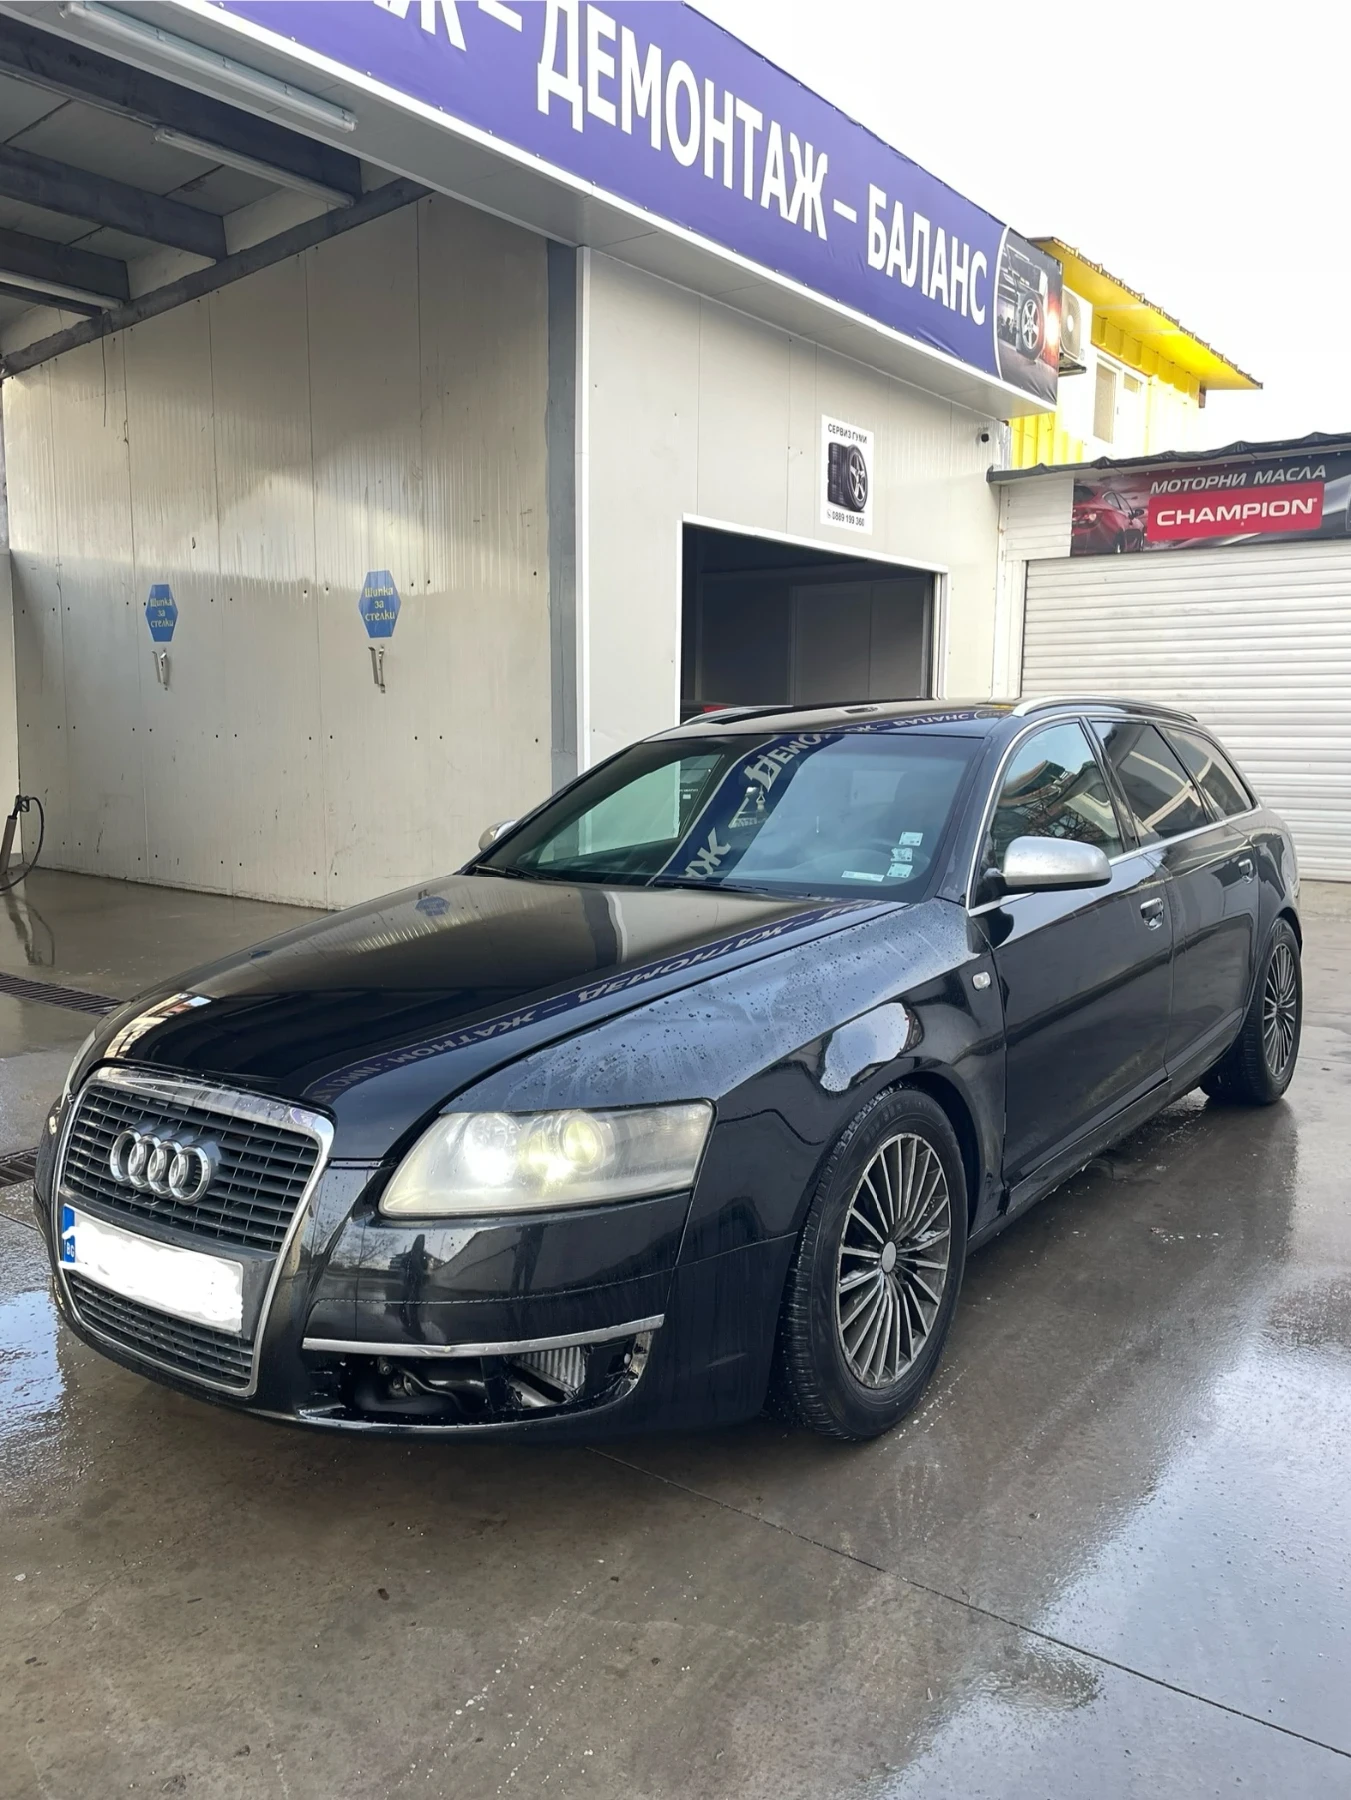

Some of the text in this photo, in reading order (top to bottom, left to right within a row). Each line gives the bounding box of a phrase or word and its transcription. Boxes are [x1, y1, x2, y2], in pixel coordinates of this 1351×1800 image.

[538, 0, 828, 241] ДЕМОНТАЖ
[867, 183, 988, 326] БАЛАНС
[828, 423, 868, 445] СЕРВИЗ ГУМИ
[1150, 464, 1327, 495] МОТОРНИ МАСЛА
[365, 586, 393, 598] Щипка
[375, 600, 384, 609] за
[365, 610, 395, 621] стелки
[66, 1241, 75, 1258] BG
